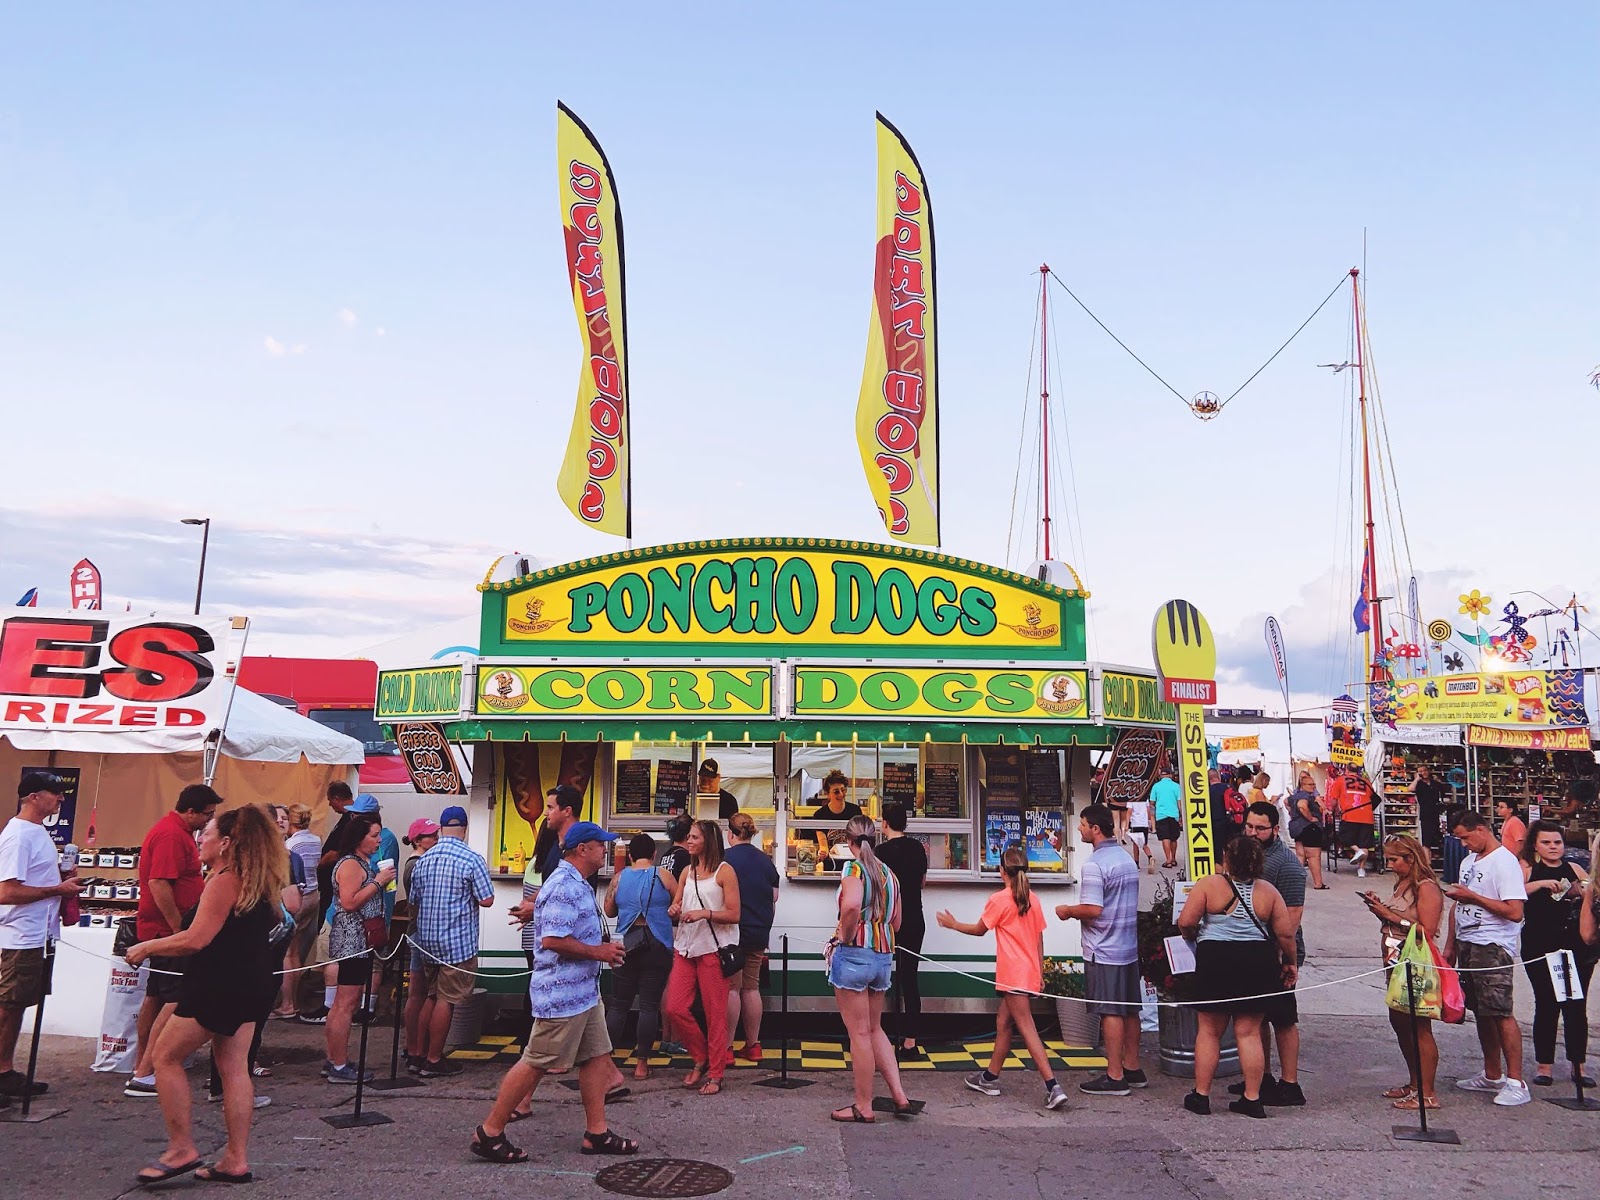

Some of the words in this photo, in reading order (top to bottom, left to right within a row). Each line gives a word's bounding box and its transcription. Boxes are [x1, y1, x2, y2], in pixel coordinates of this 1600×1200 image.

[568, 556, 819, 634] PONCHO
[831, 560, 998, 636] DOGS
[512, 622, 536, 631] PONCHO
[537, 622, 549, 630] DOG
[1018, 627, 1042, 636] PONCHO
[1043, 627, 1056, 636] DOG
[0, 616, 215, 702] ES
[381, 674, 411, 713] COLD
[412, 670, 462, 712] DRINKS
[529, 669, 770, 710] CORN
[796, 670, 1036, 713] DOGS
[1103, 675, 1135, 718] COLD
[1171, 681, 1211, 700] FINALIST
[1447, 681, 1478, 692] MATCHBOX
[4, 701, 207, 727] RIZED
[1040, 701, 1063, 711] PONCHO
[1184, 712, 1200, 723] THE
[400, 731, 441, 751] CHEESE
[1469, 725, 1501, 745] BEANIE
[1500, 730, 1533, 747] BABIES
[1542, 729, 1567, 748] $5.00
[1567, 728, 1589, 749] each
[1117, 737, 1163, 758] CHEESE
[1333, 747, 1363, 758] HALOS
[413, 751, 443, 771] CURD
[1117, 758, 1148, 779] CURD
[414, 771, 458, 791] TACOS
[1106, 778, 1149, 799] TACOS
[1184, 724, 1211, 881] SPORKIE
[1025, 810, 1049, 820] CRAZY
[1026, 825, 1041, 837] DAY
[1028, 840, 1045, 848] $2.00
[111, 977, 124, 986] STATE
[124, 977, 139, 987] FAIR
[112, 968, 140, 978] WISCONSIN
[113, 1044, 127, 1053] FAIR
